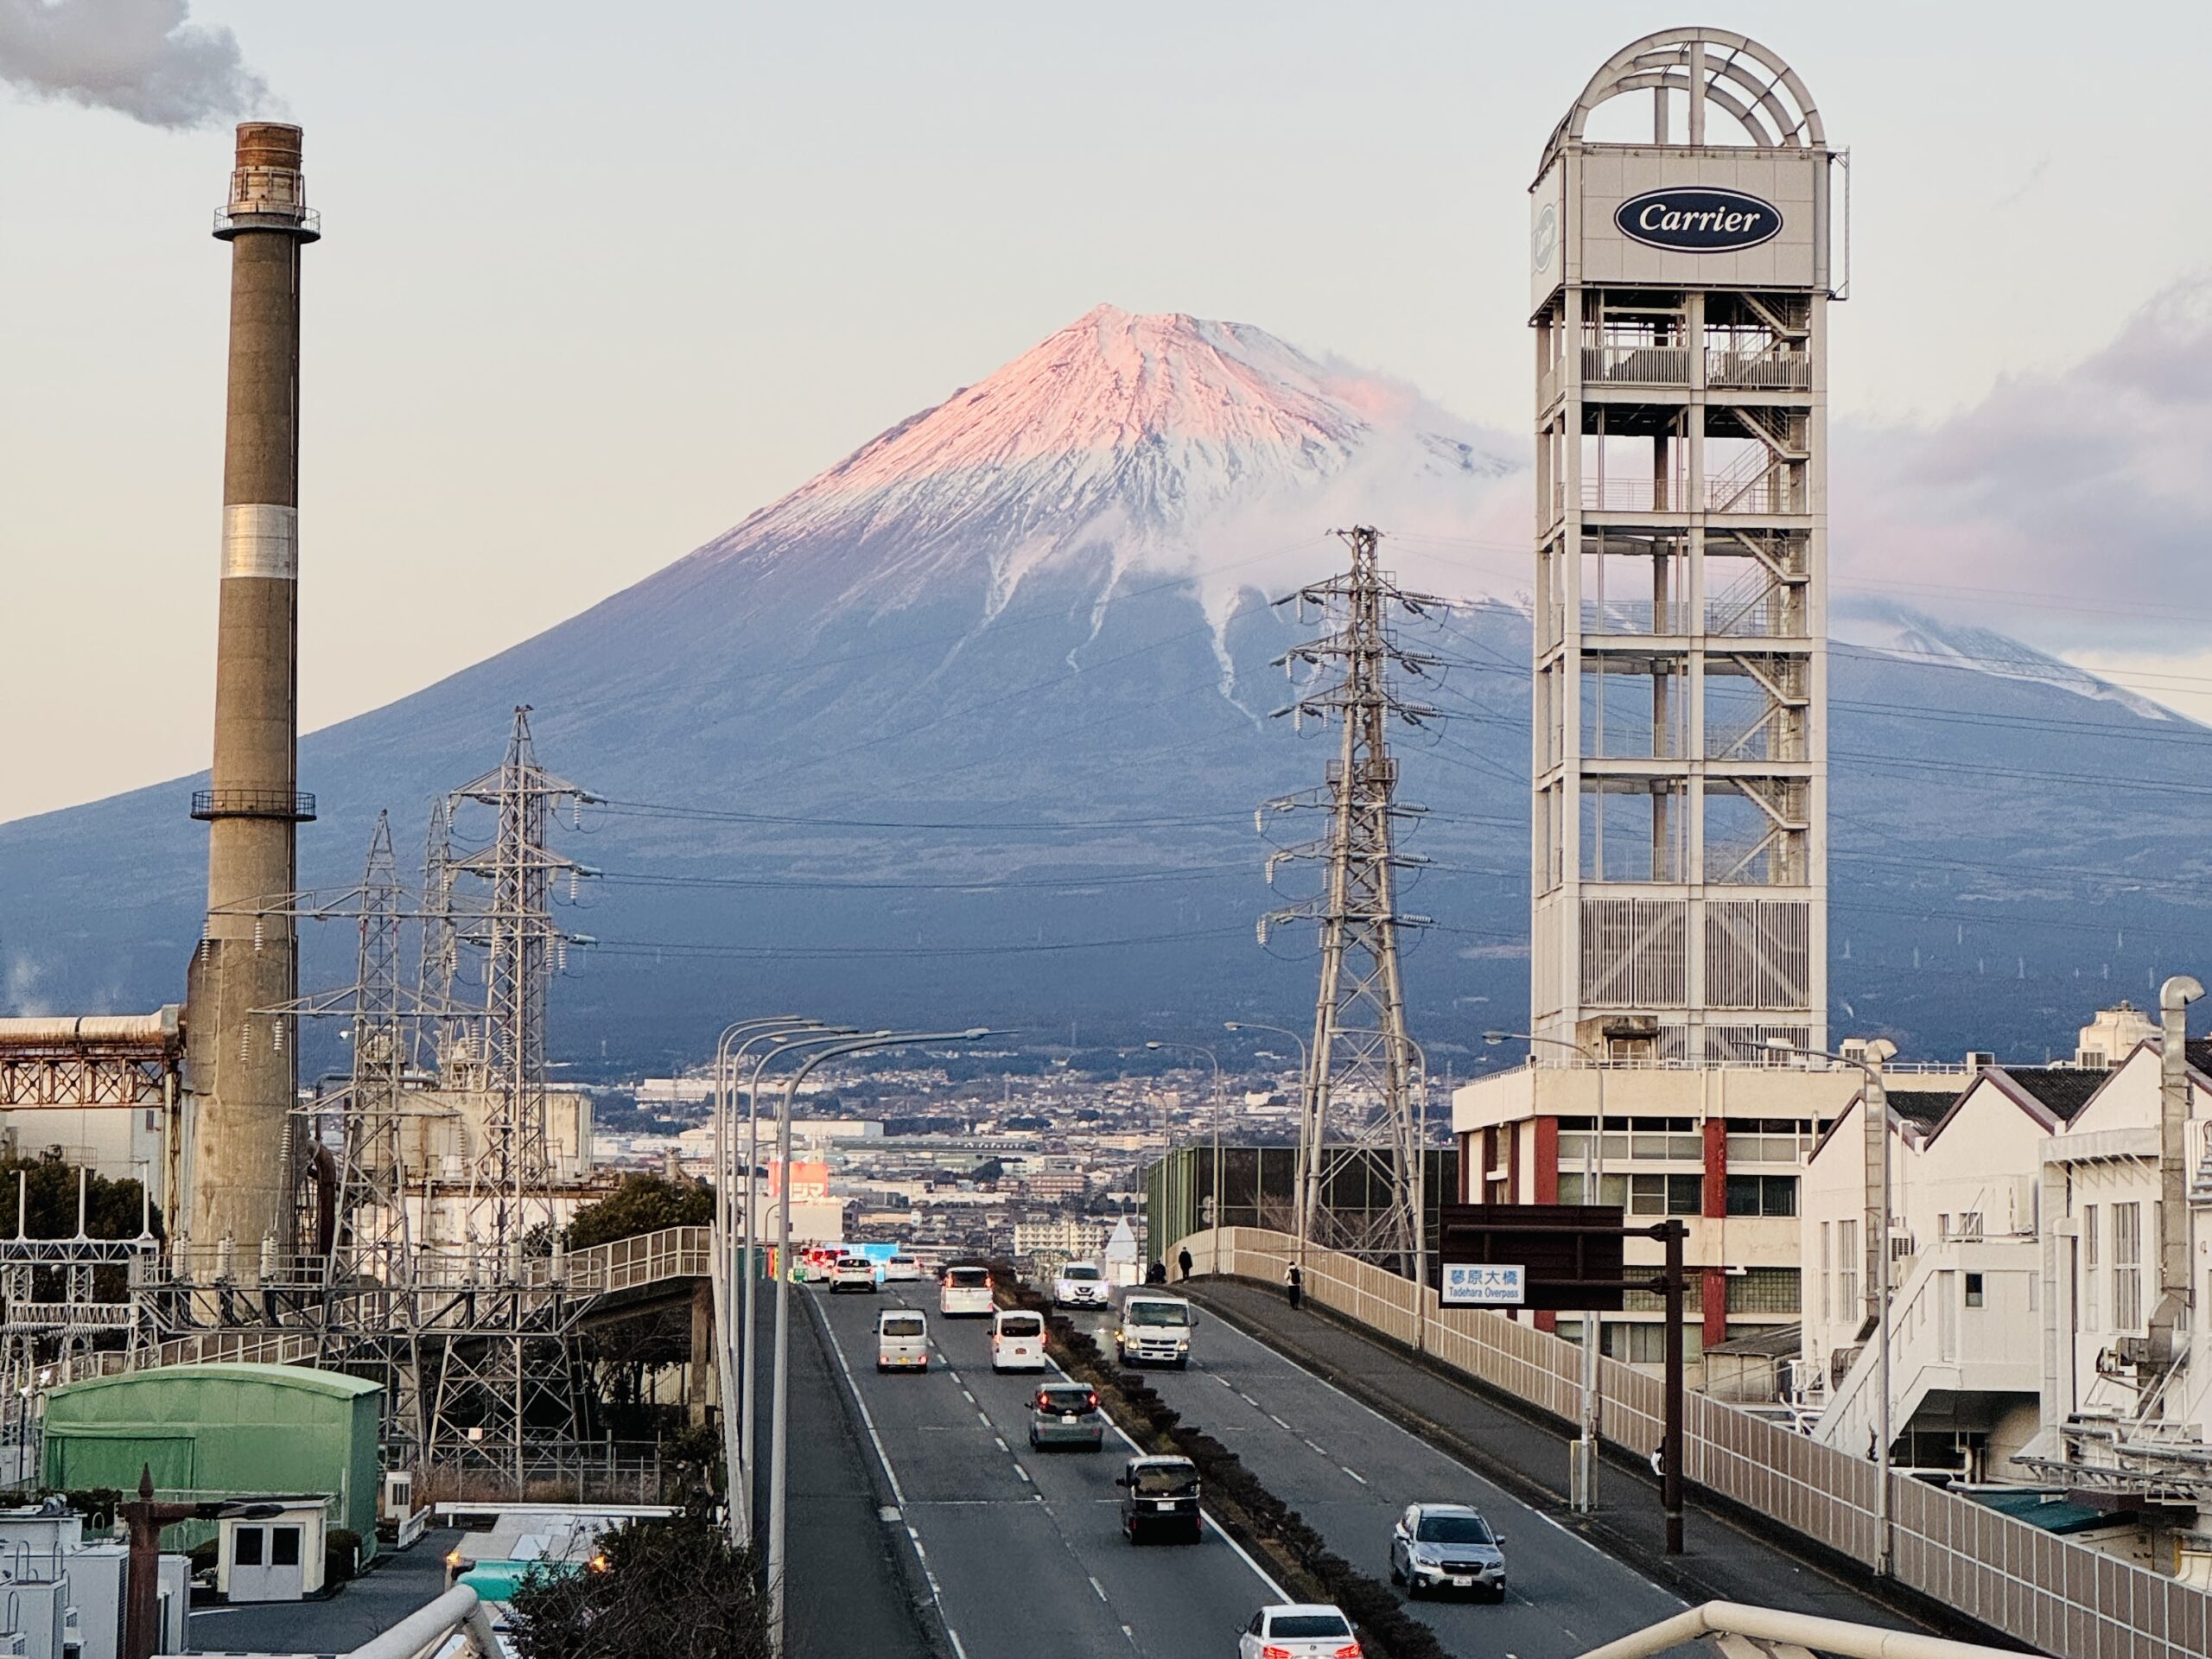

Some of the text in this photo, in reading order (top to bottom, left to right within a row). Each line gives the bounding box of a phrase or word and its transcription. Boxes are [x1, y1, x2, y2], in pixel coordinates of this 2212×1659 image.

[1639, 204, 1760, 232] Carrier
[1449, 1287, 1519, 1299] Tadehara Overpass
